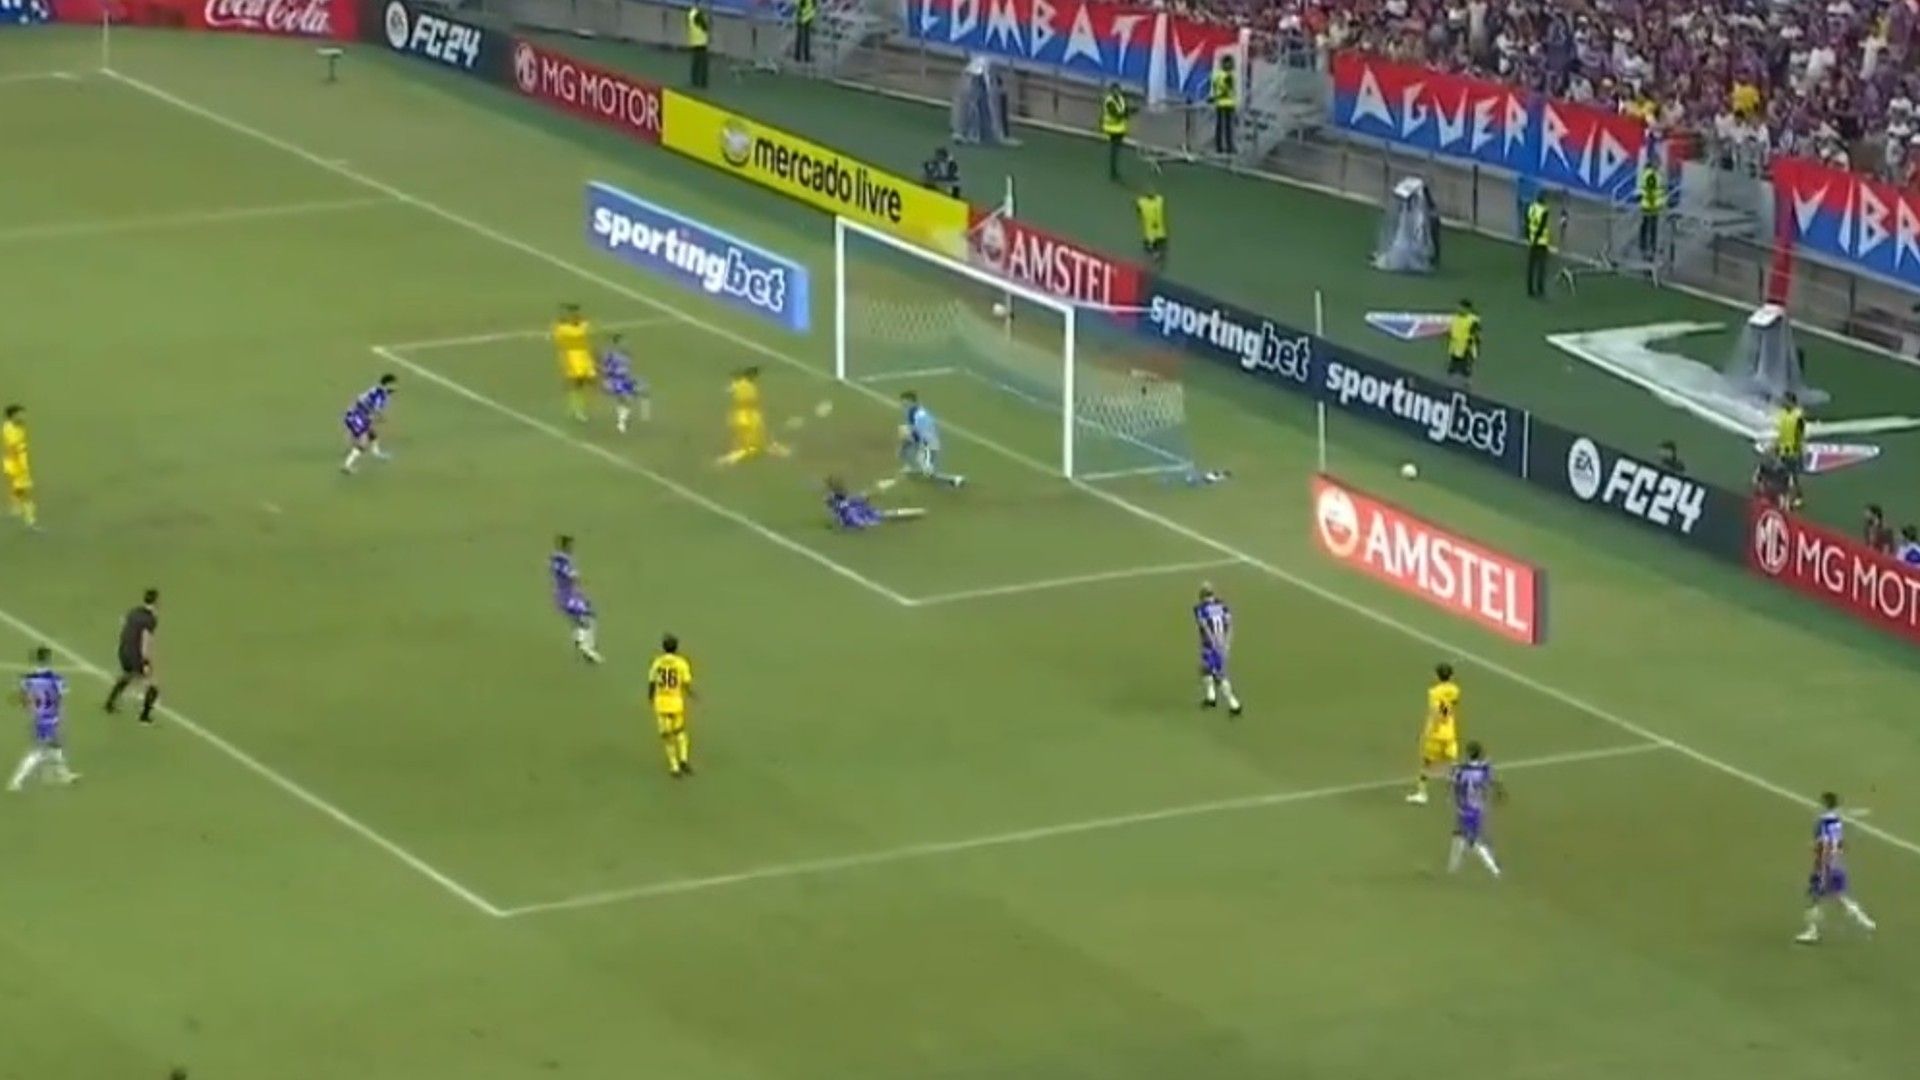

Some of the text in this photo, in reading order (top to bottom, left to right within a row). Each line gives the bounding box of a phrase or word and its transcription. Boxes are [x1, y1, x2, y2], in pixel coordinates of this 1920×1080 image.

[542, 57, 662, 132] MG MOTOR
[755, 137, 901, 223] mercado livre
[594, 207, 785, 313] sportingbet
[1150, 294, 1311, 382] sportingbet
[1326, 361, 1507, 457] sportingbet
[1363, 509, 1528, 631] AMSTEL
[1796, 530, 1846, 593] MG
